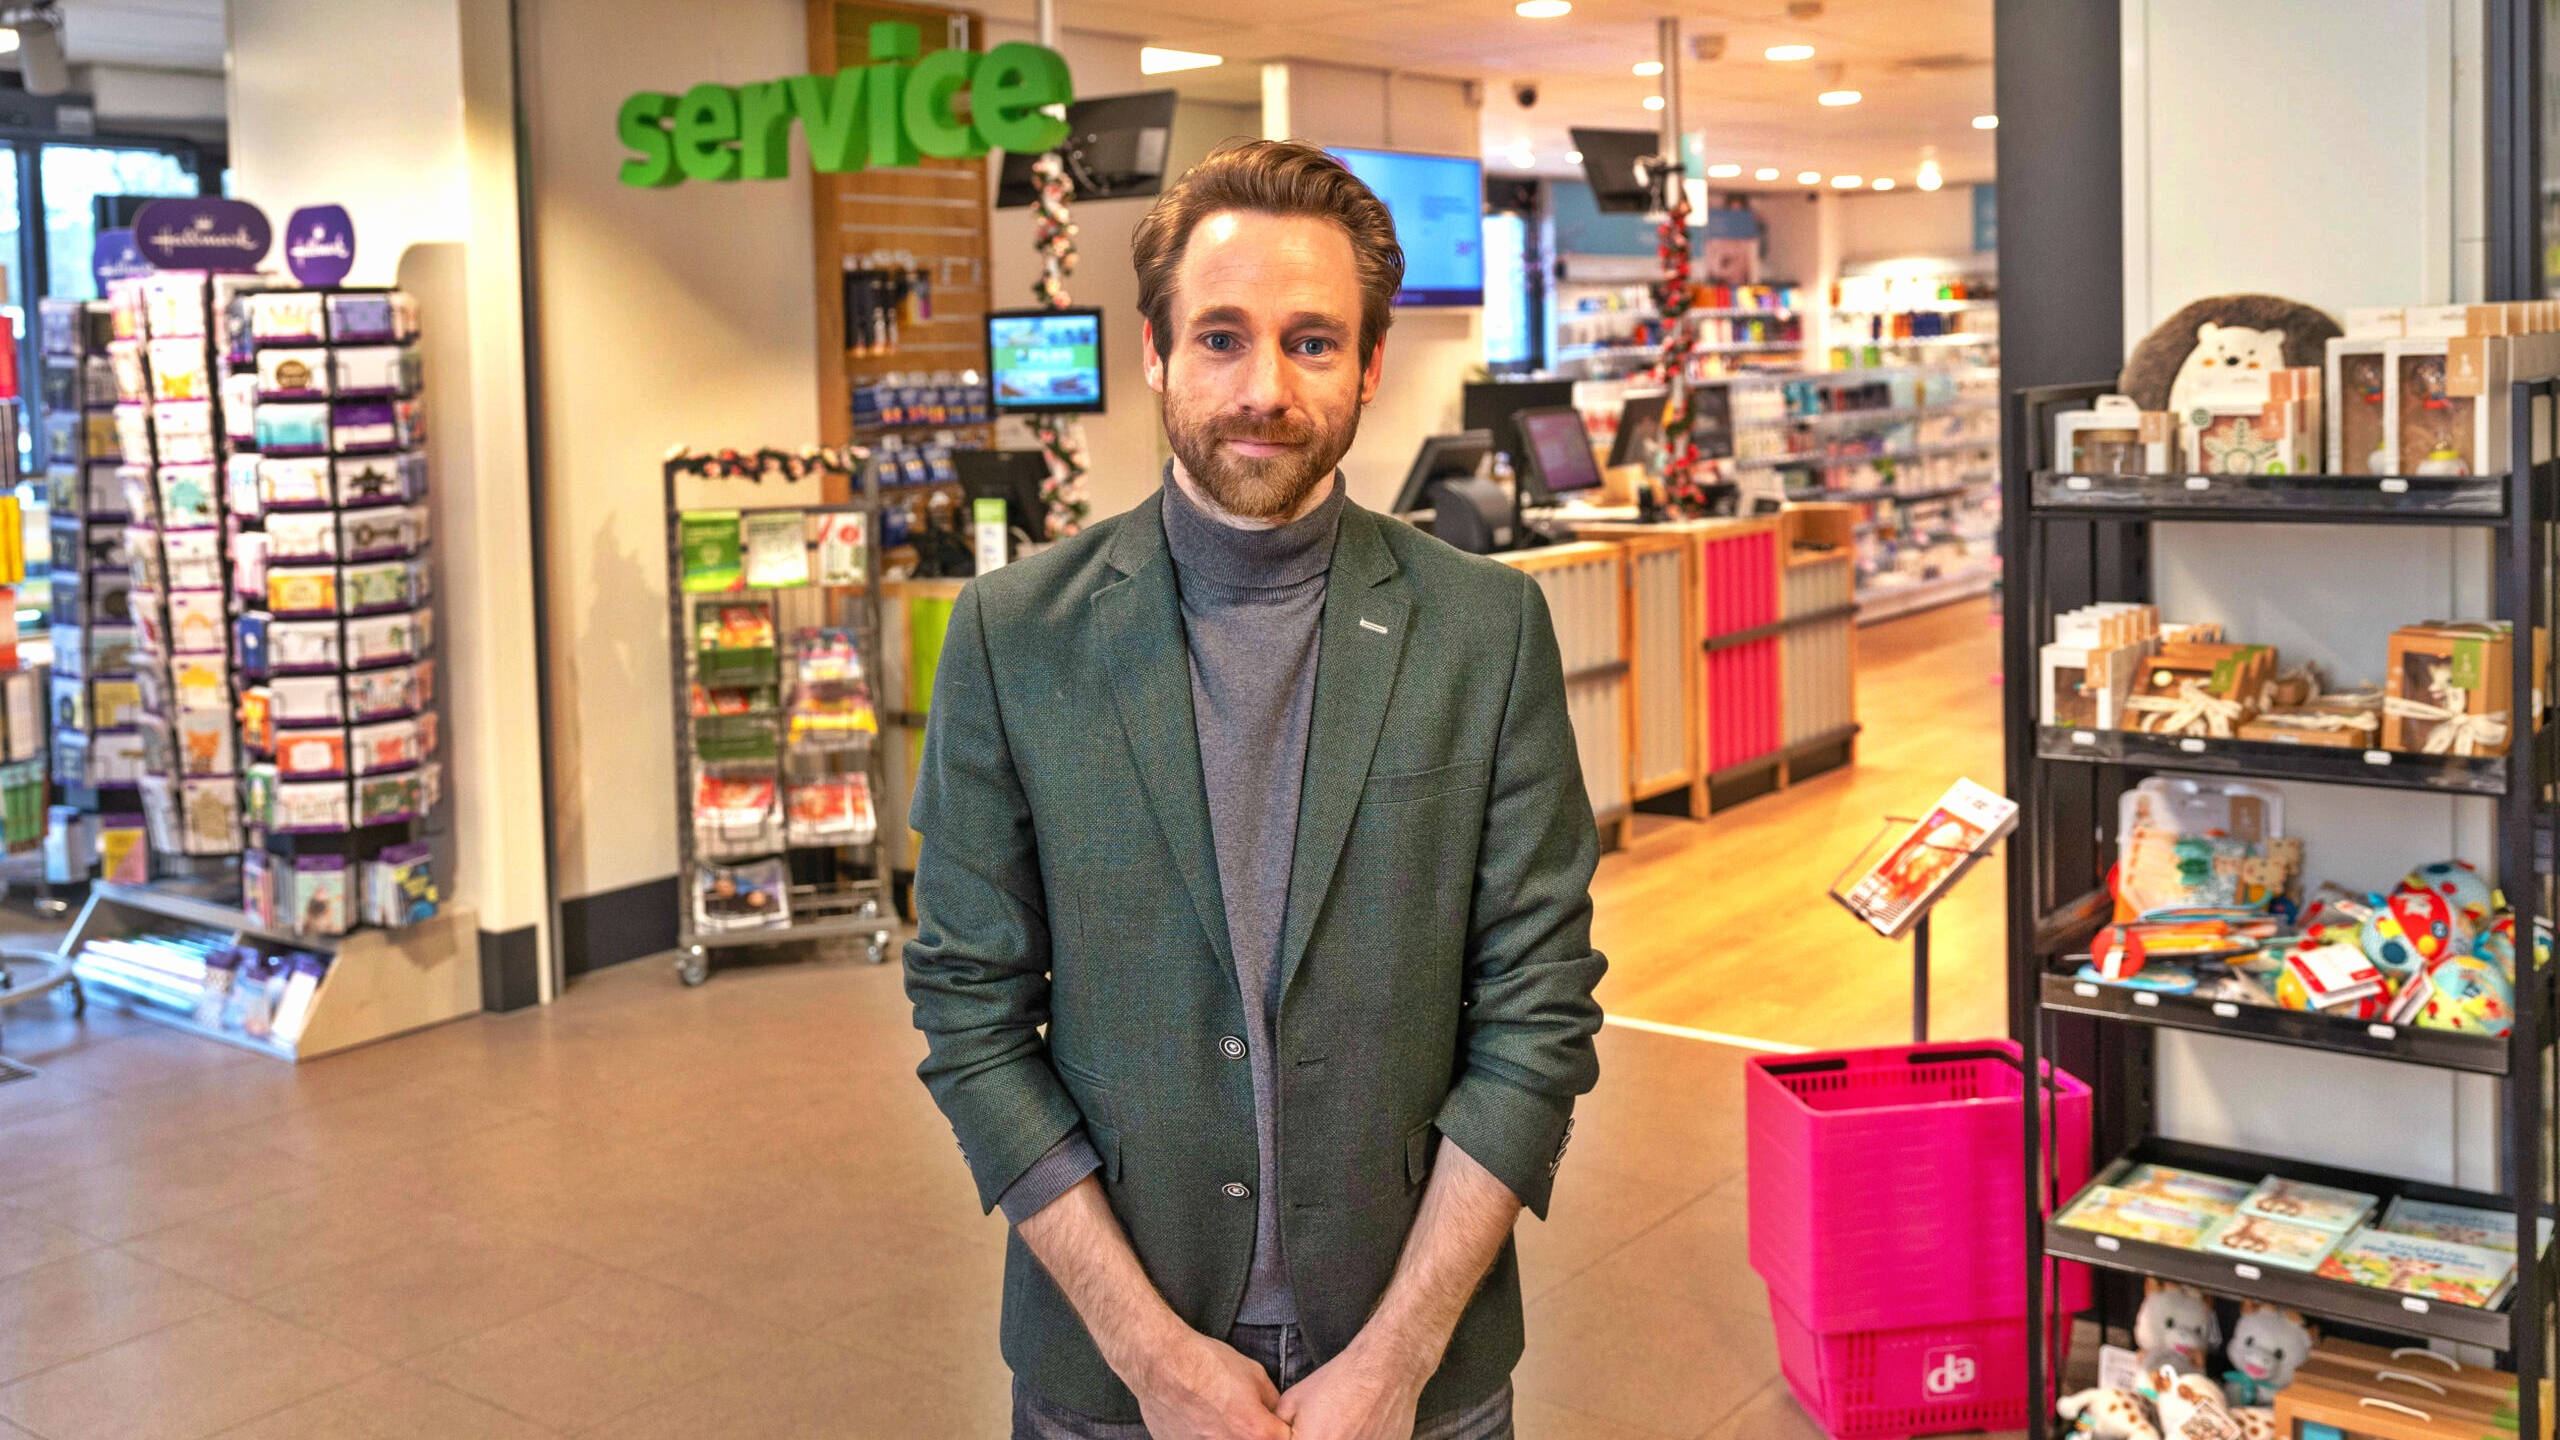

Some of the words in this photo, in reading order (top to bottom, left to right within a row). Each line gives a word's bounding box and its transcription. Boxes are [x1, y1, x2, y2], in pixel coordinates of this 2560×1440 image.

[618, 22, 1074, 187] service
[151, 223, 258, 256] Hallmark
[1926, 1353, 1976, 1394] da
